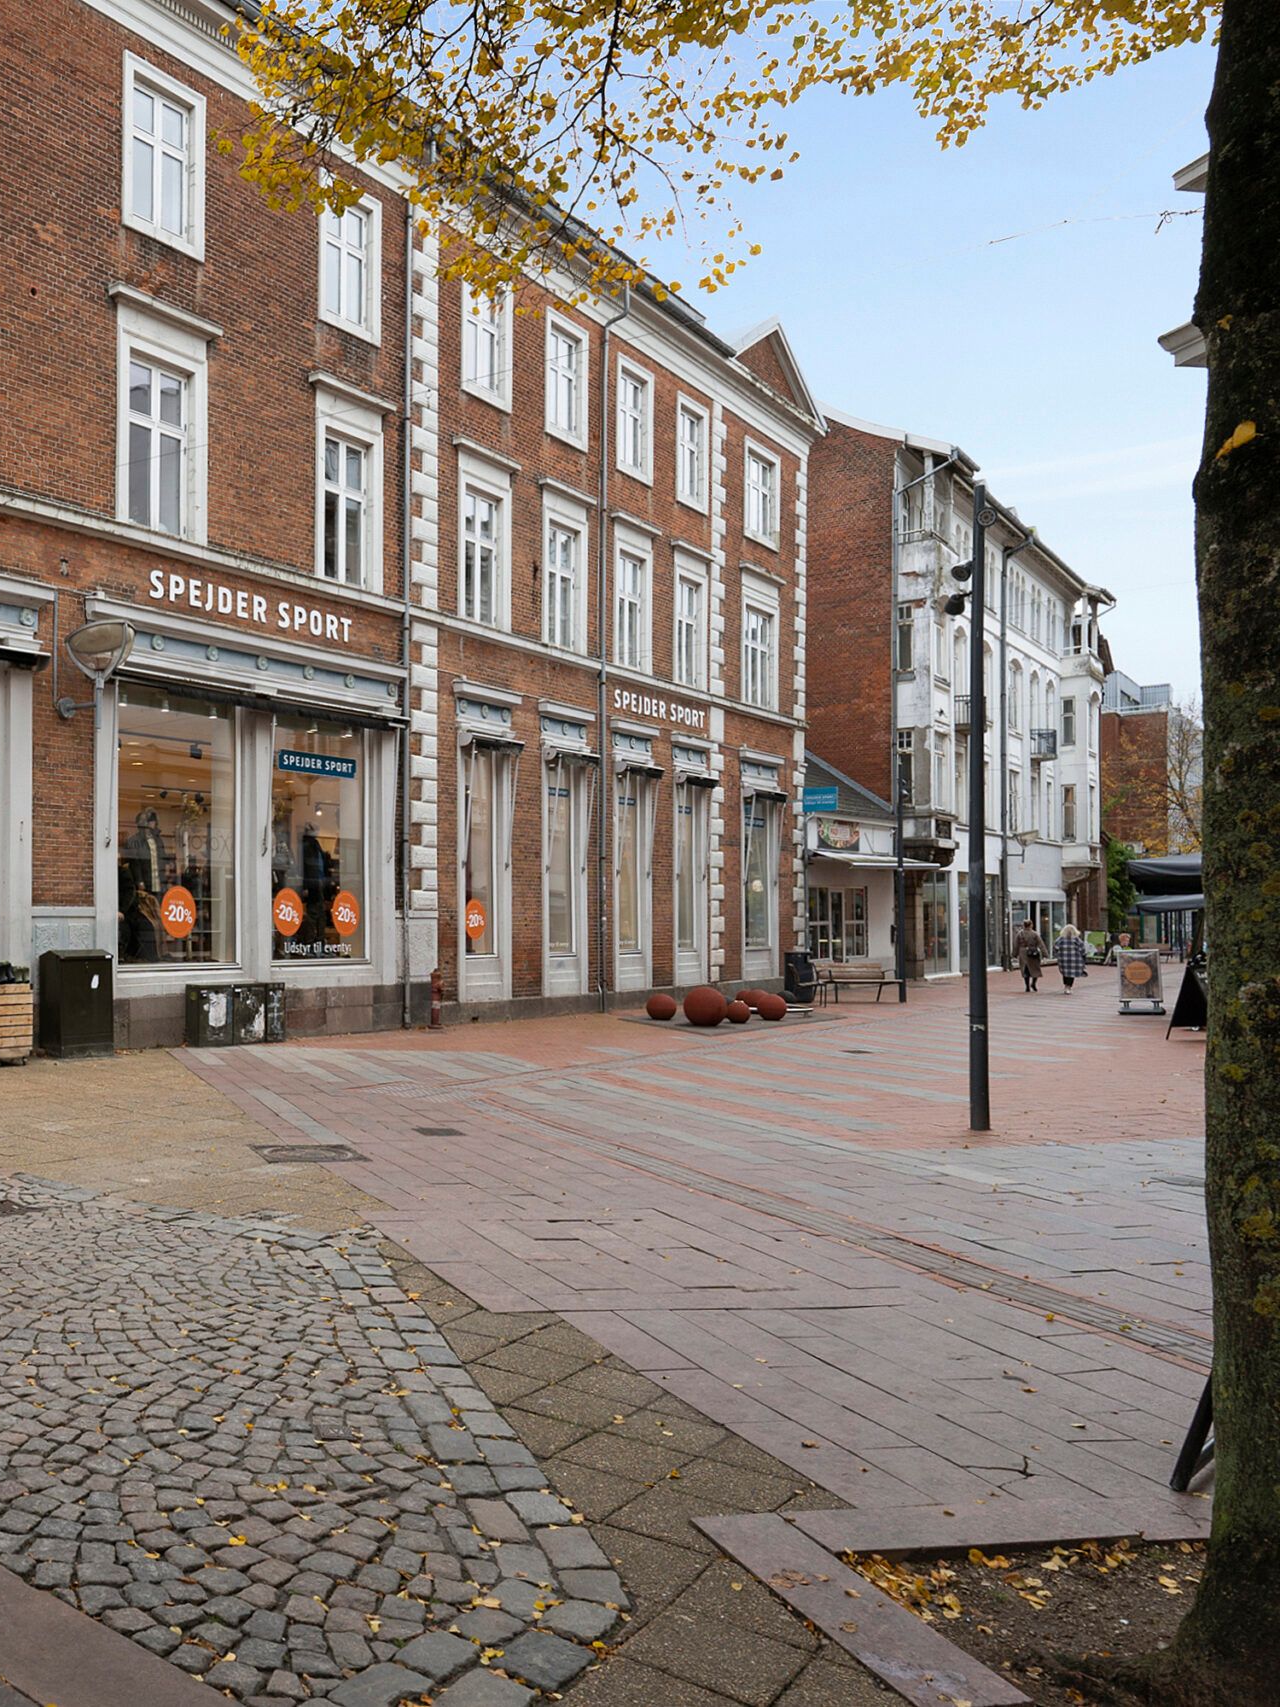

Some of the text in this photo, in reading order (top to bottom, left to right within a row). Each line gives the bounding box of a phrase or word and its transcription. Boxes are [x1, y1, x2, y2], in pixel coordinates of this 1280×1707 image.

[149, 569, 352, 643] SPEJDER SPORT
[614, 688, 705, 729] SPEJDER SPORT
[283, 754, 353, 774] SPEJDER SPORT
[163, 904, 193, 924] -20%
[276, 904, 300, 925] -20%
[335, 906, 357, 925] -20%
[284, 941, 311, 956] Udstyr
[313, 941, 323, 953] til
